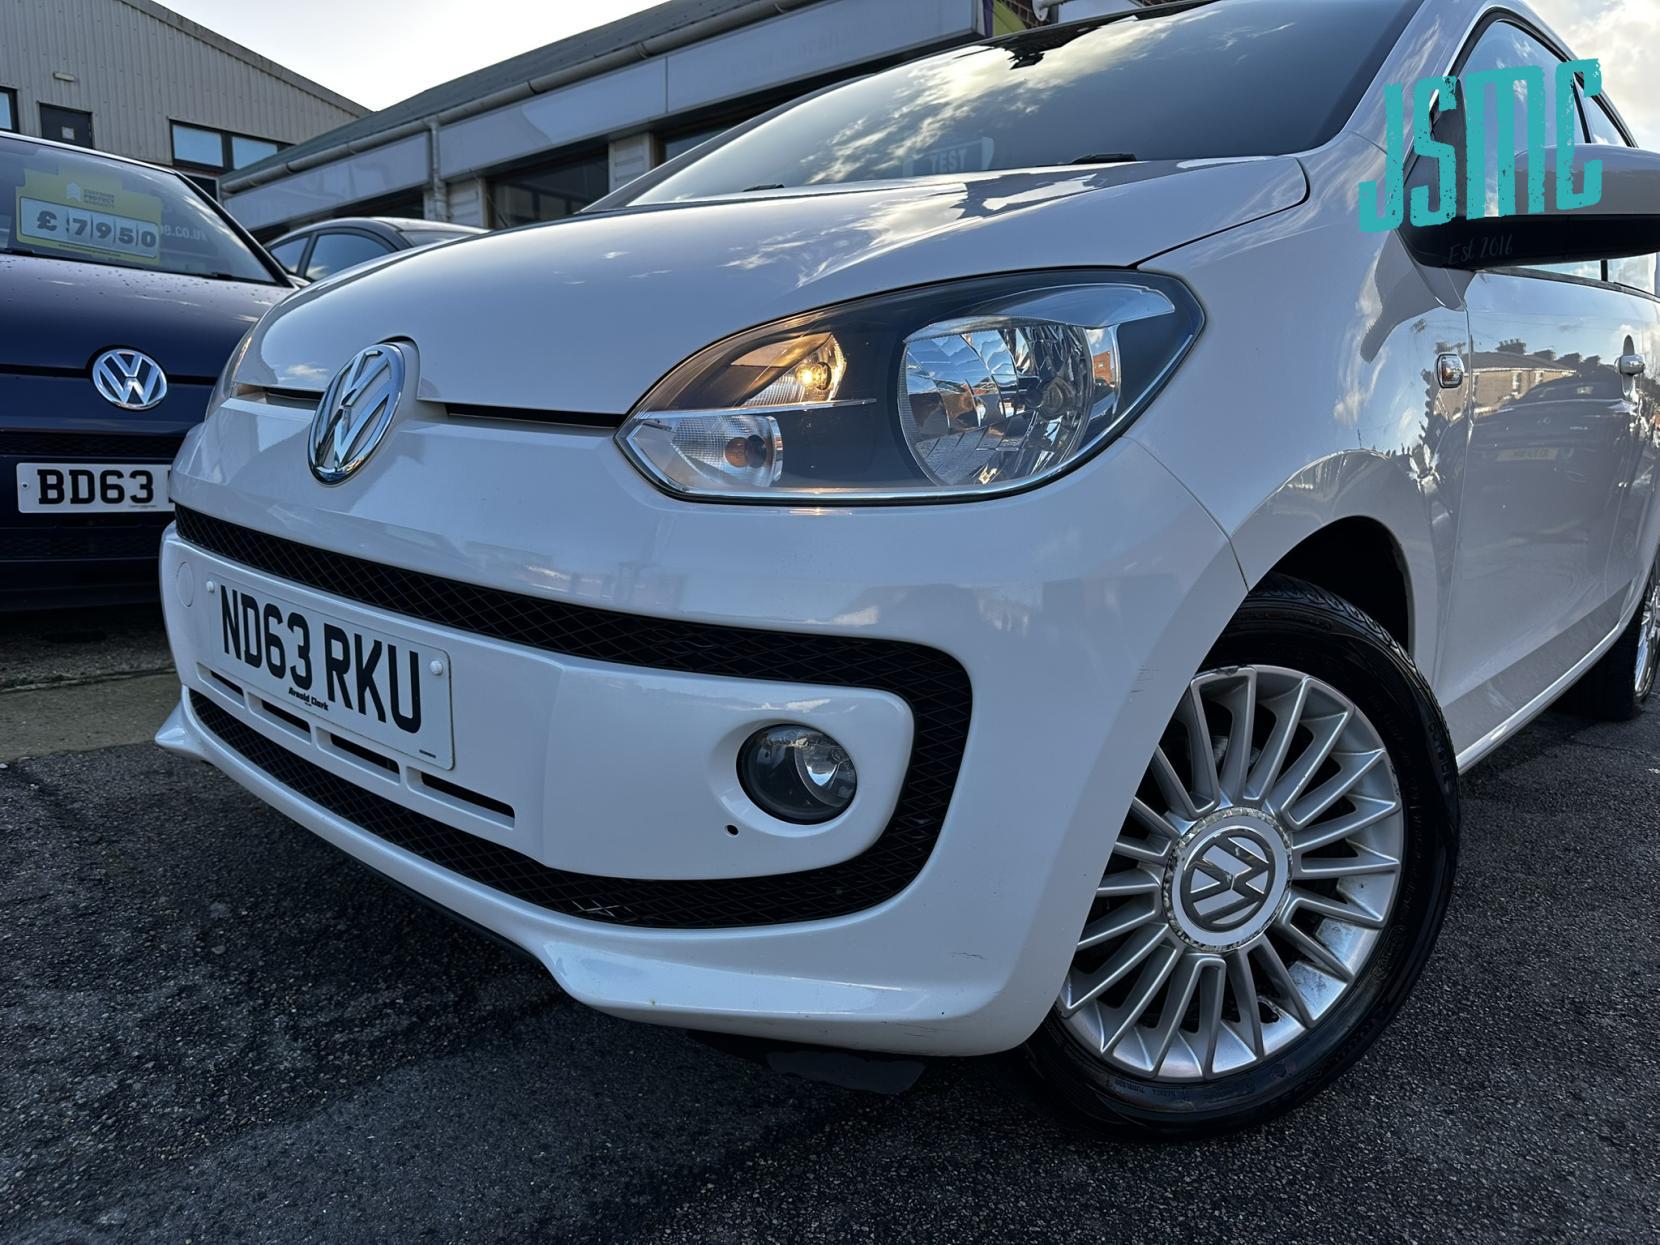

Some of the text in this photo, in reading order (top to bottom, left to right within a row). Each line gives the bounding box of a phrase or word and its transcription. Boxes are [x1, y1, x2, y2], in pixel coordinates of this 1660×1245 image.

[37, 468, 154, 505] BD63
[221, 584, 421, 734] ND63 RKU
